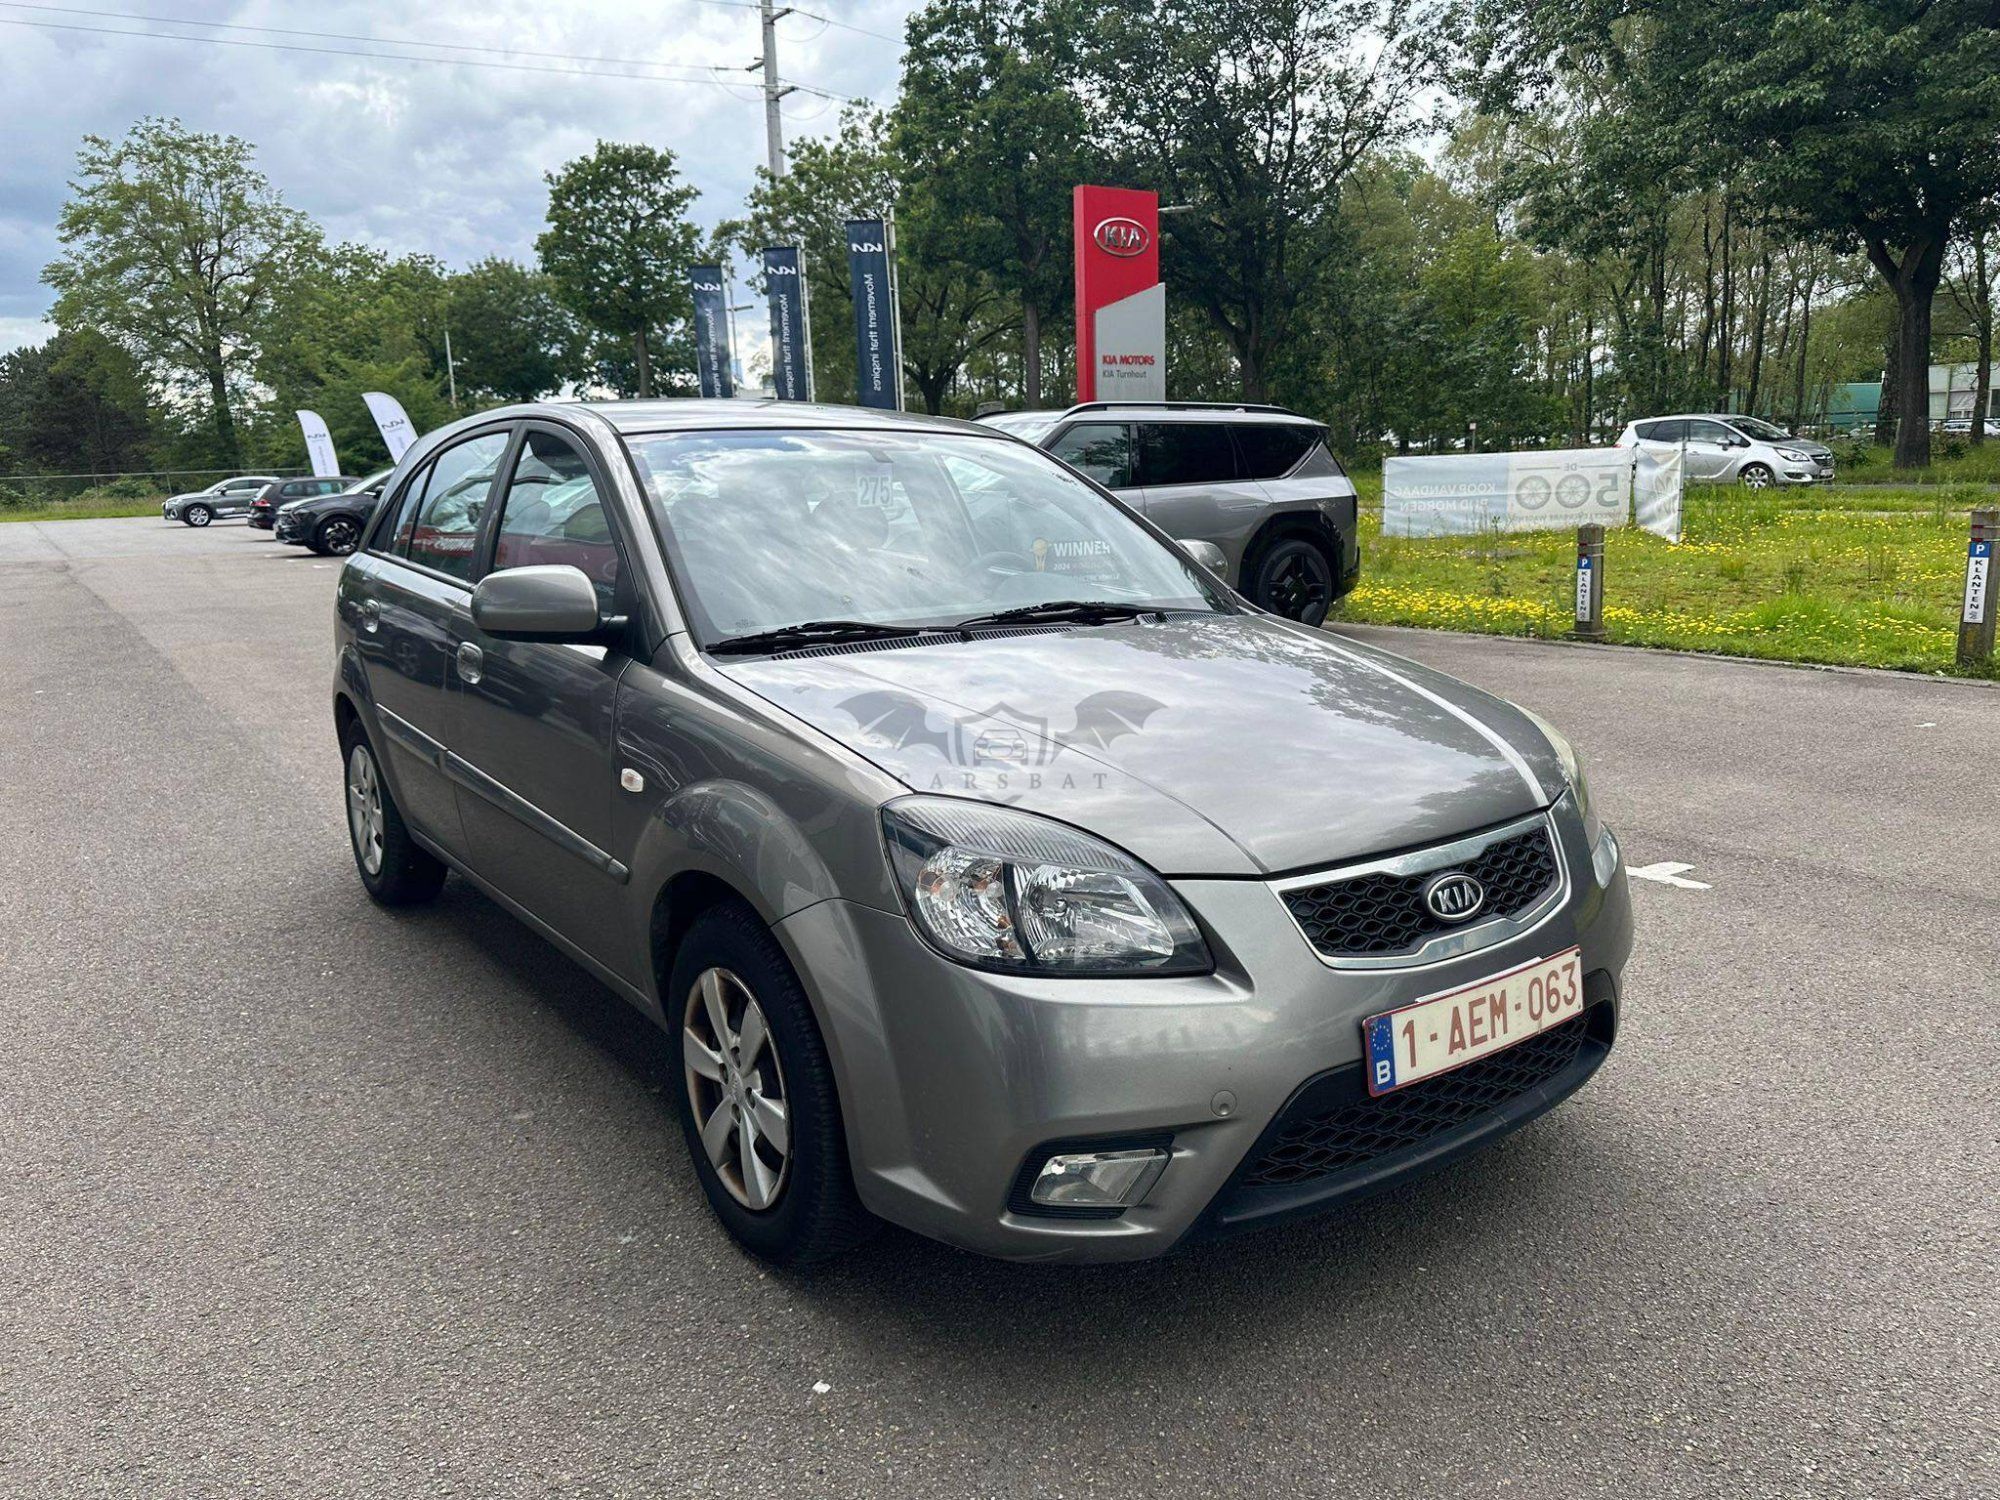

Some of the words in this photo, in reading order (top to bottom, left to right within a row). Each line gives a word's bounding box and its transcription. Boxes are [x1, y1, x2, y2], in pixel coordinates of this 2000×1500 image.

[1103, 226, 1142, 248] KIA
[1102, 354, 1118, 365] KIA
[1119, 354, 1155, 365] MOTORS
[1116, 369, 1147, 378] Turnhout
[858, 478, 890, 505] 275
[1975, 544, 1985, 555] P
[1581, 558, 1588, 567] P
[1970, 560, 1983, 609] KLANTEN
[1436, 880, 1477, 913] KIA
[1402, 961, 1577, 1068] 1-AEM-063
[1377, 1060, 1391, 1085] B
